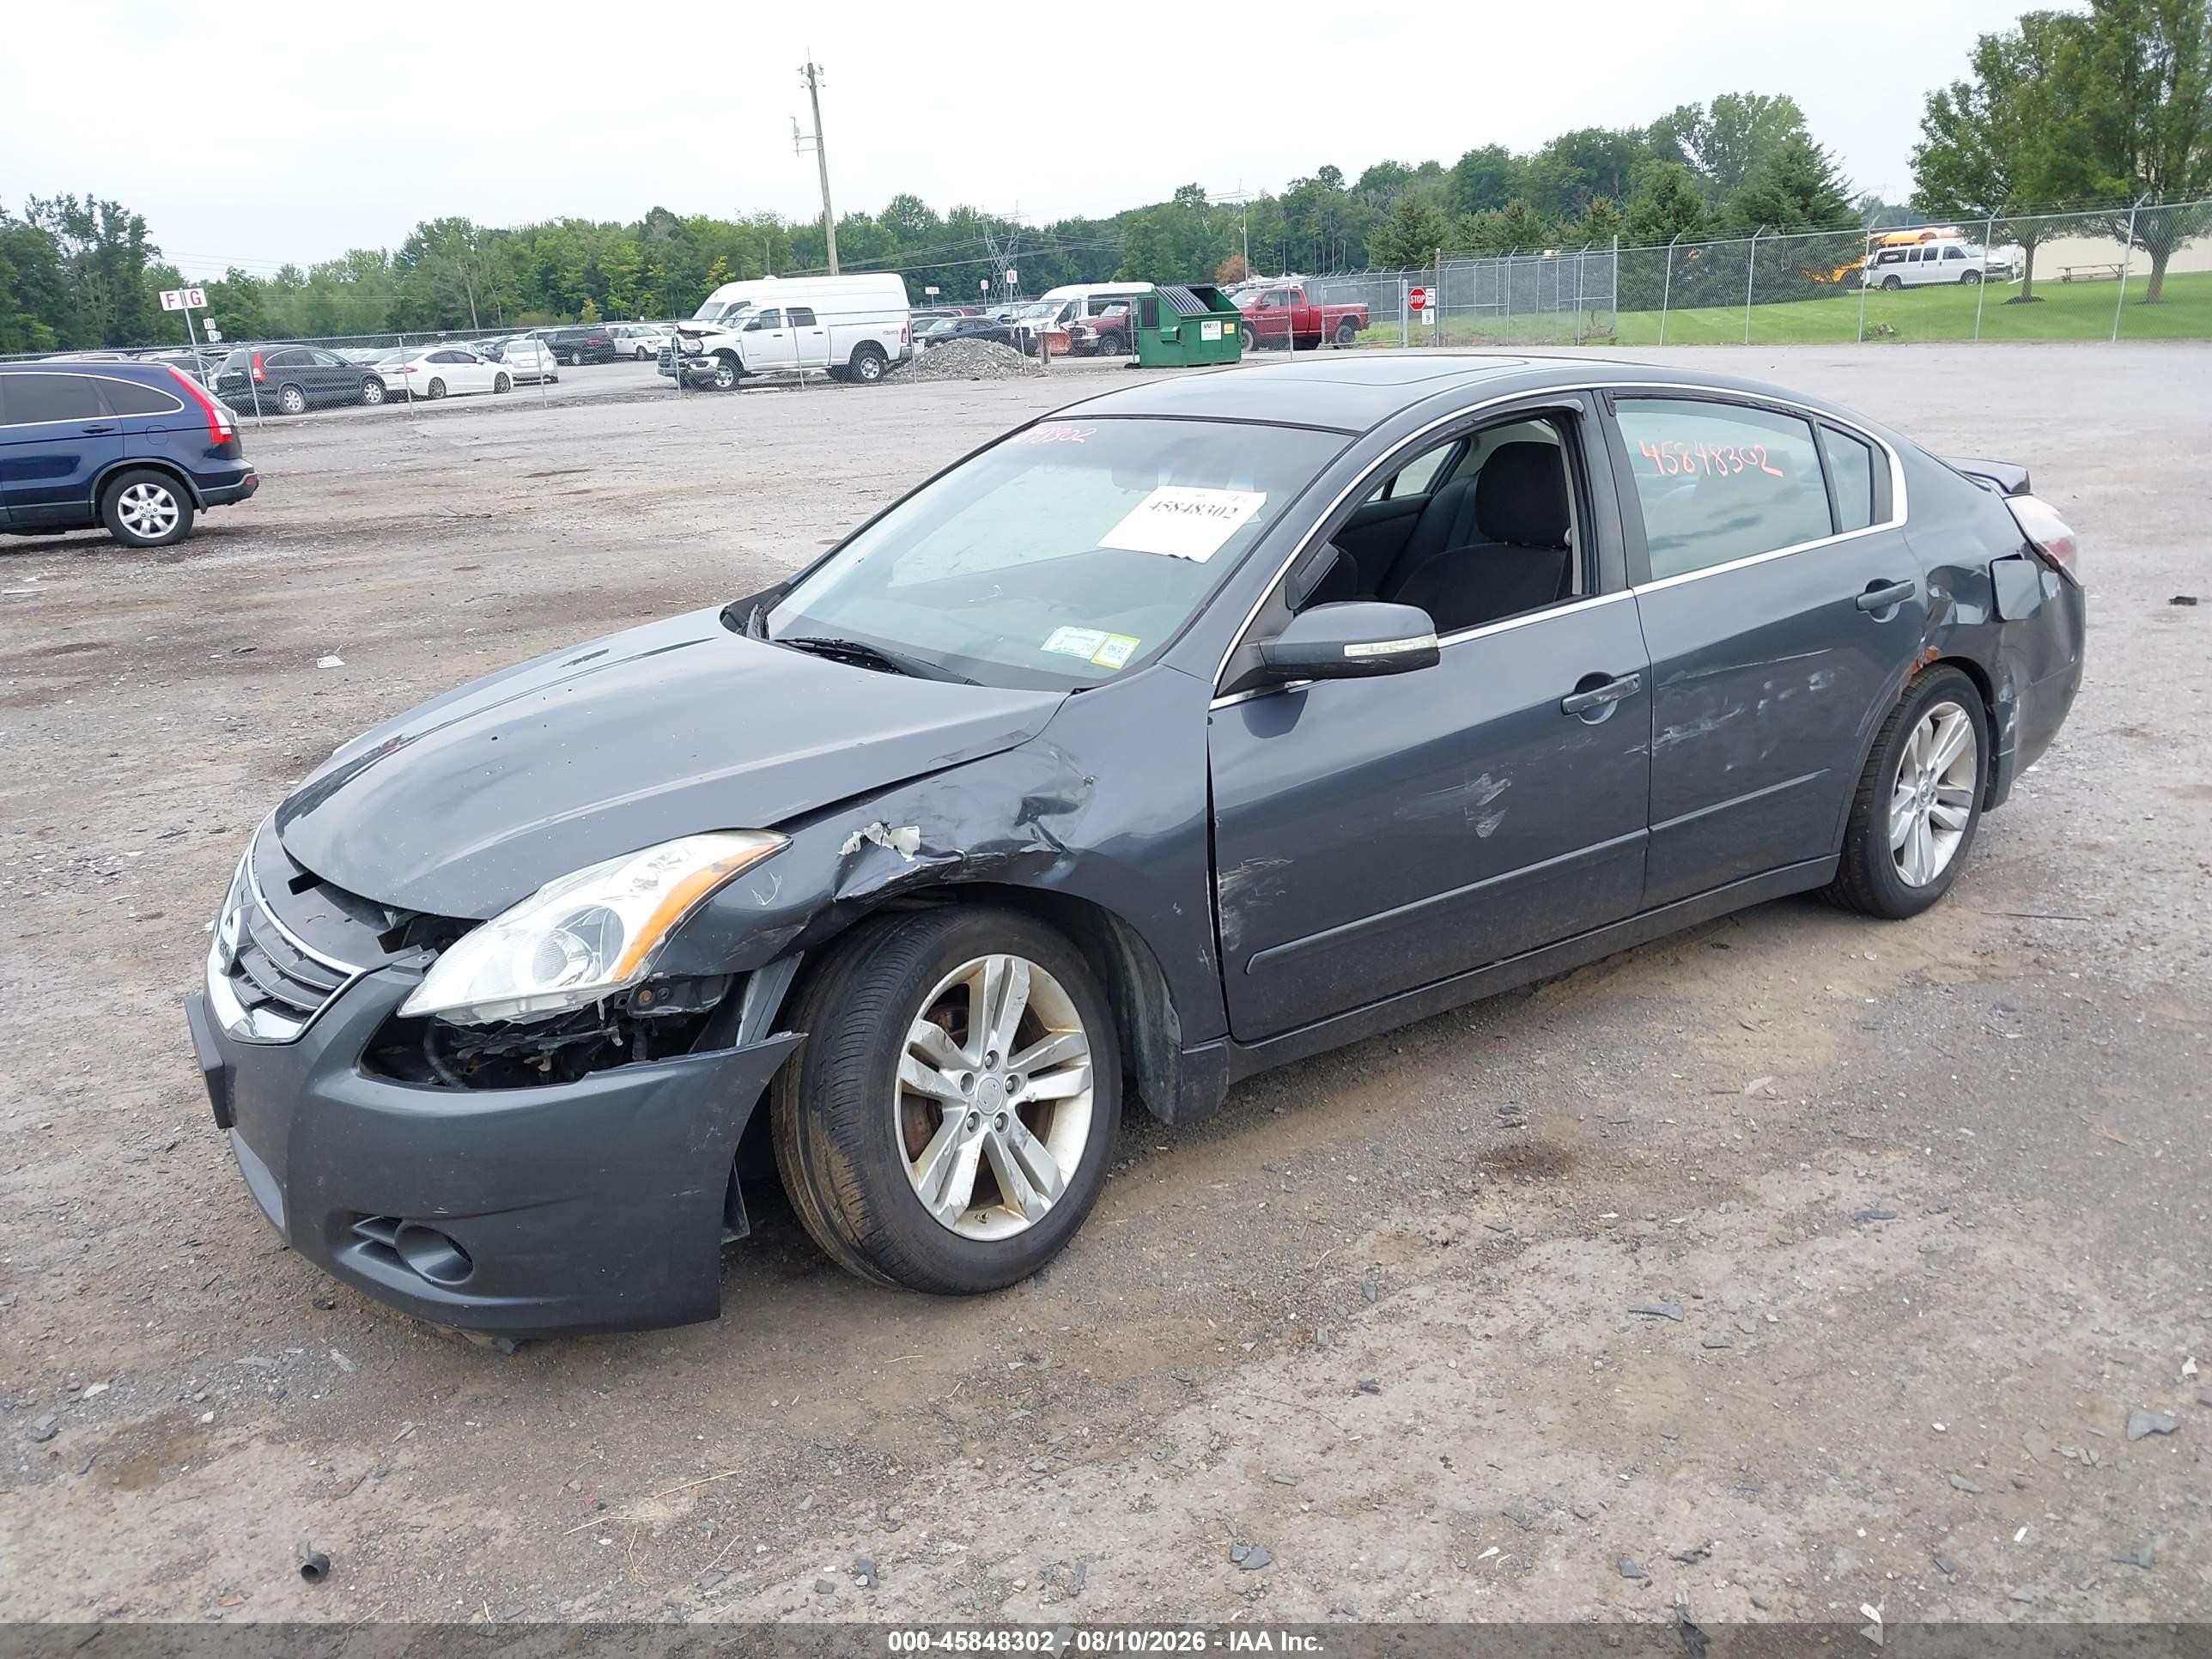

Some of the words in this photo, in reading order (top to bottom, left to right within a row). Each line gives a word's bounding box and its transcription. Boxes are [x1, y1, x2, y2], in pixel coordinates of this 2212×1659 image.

[1410, 295, 1425, 304] STOP
[204, 319, 215, 328] 10
[1638, 439, 1784, 477] 45848302
[1149, 500, 1239, 519] 45848302
